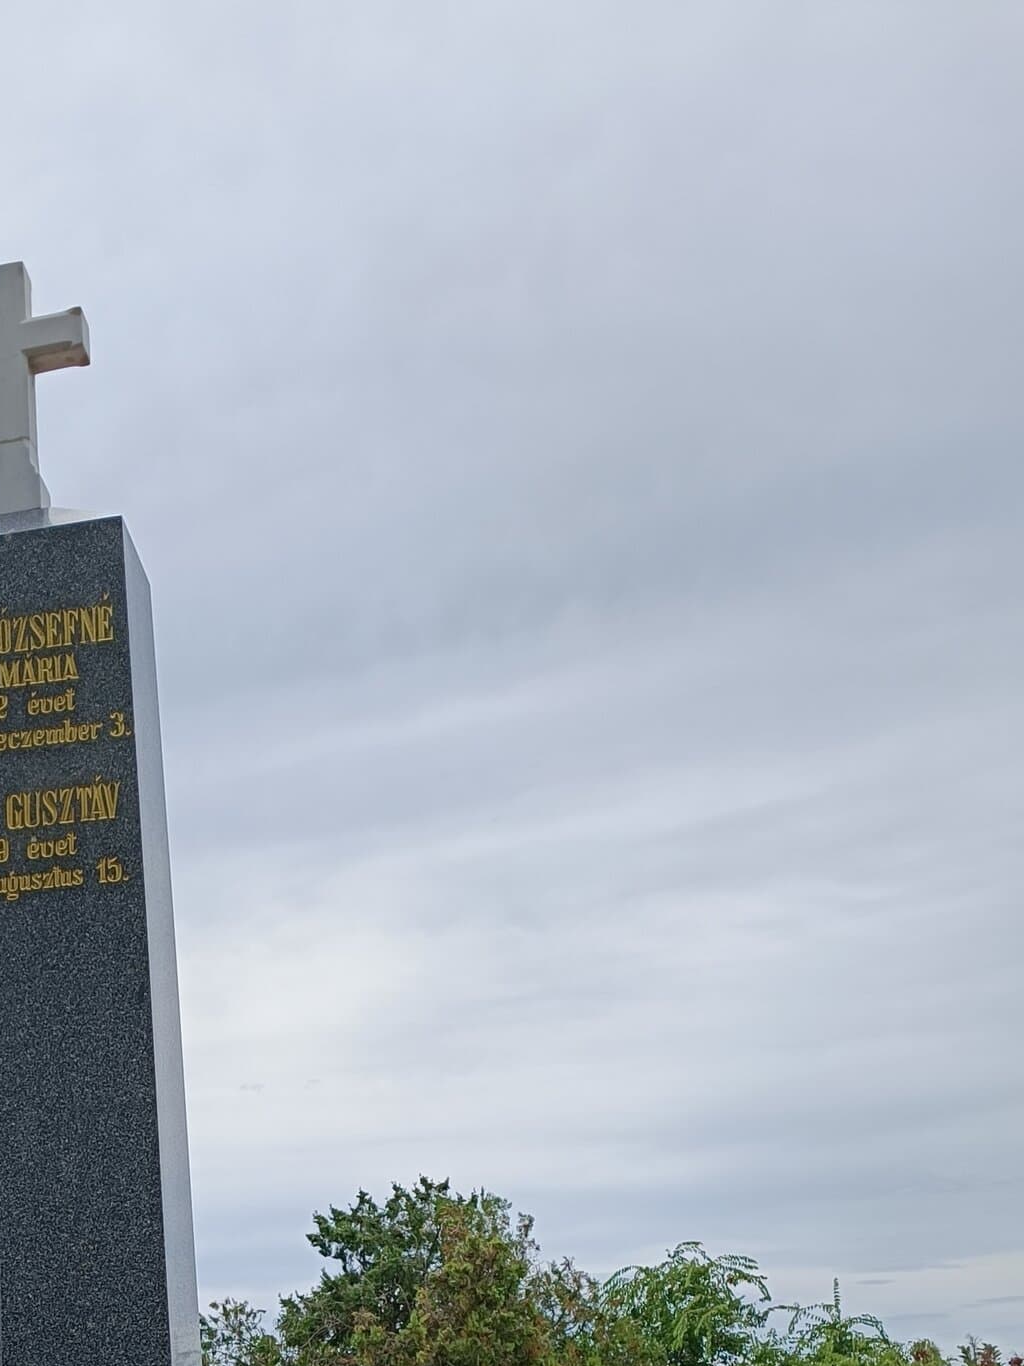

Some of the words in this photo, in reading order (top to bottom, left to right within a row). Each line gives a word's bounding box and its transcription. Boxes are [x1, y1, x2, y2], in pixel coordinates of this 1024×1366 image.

[27, 688, 76, 716] évet
[110, 711, 132, 737] 3.
[6, 775, 121, 830] GUSZTÁV
[27, 831, 77, 859] évet
[96, 856, 130, 884] 15.
